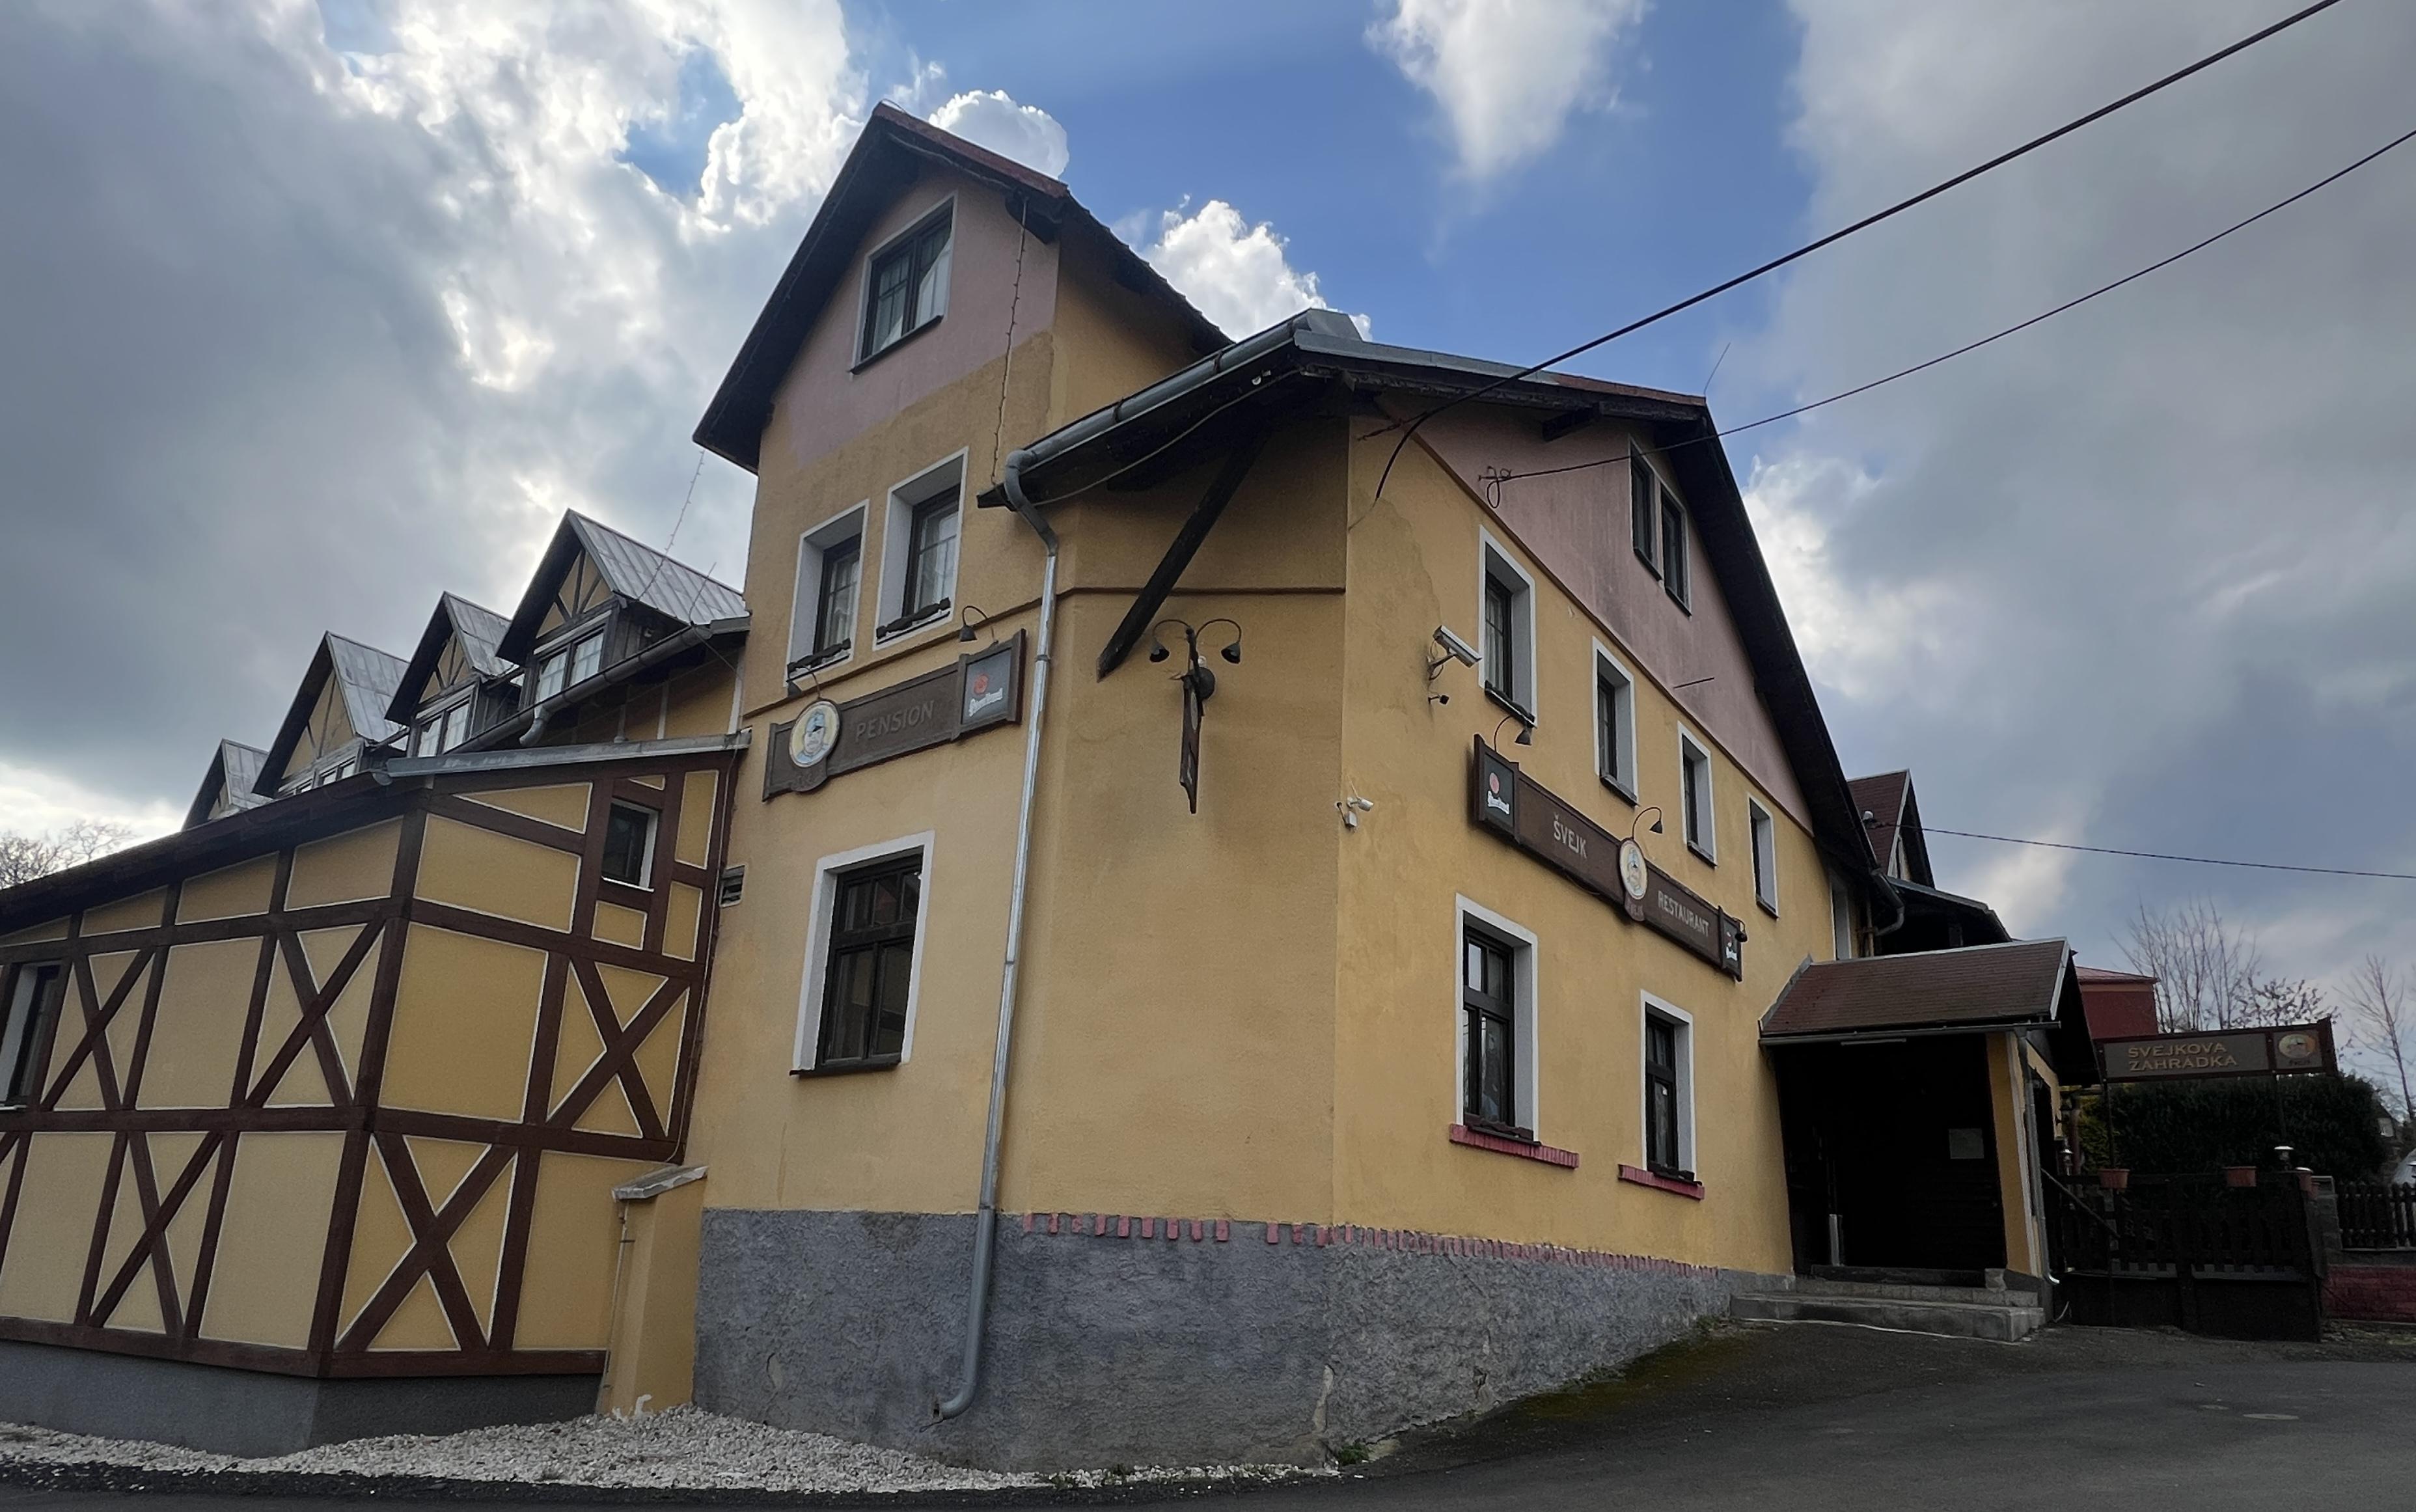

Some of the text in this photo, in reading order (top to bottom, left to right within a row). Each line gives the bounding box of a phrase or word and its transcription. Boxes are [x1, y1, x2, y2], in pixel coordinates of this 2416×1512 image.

[855, 700, 935, 743] PENSION
[1554, 812, 1709, 937] ŠVEJK RESTAURANT
